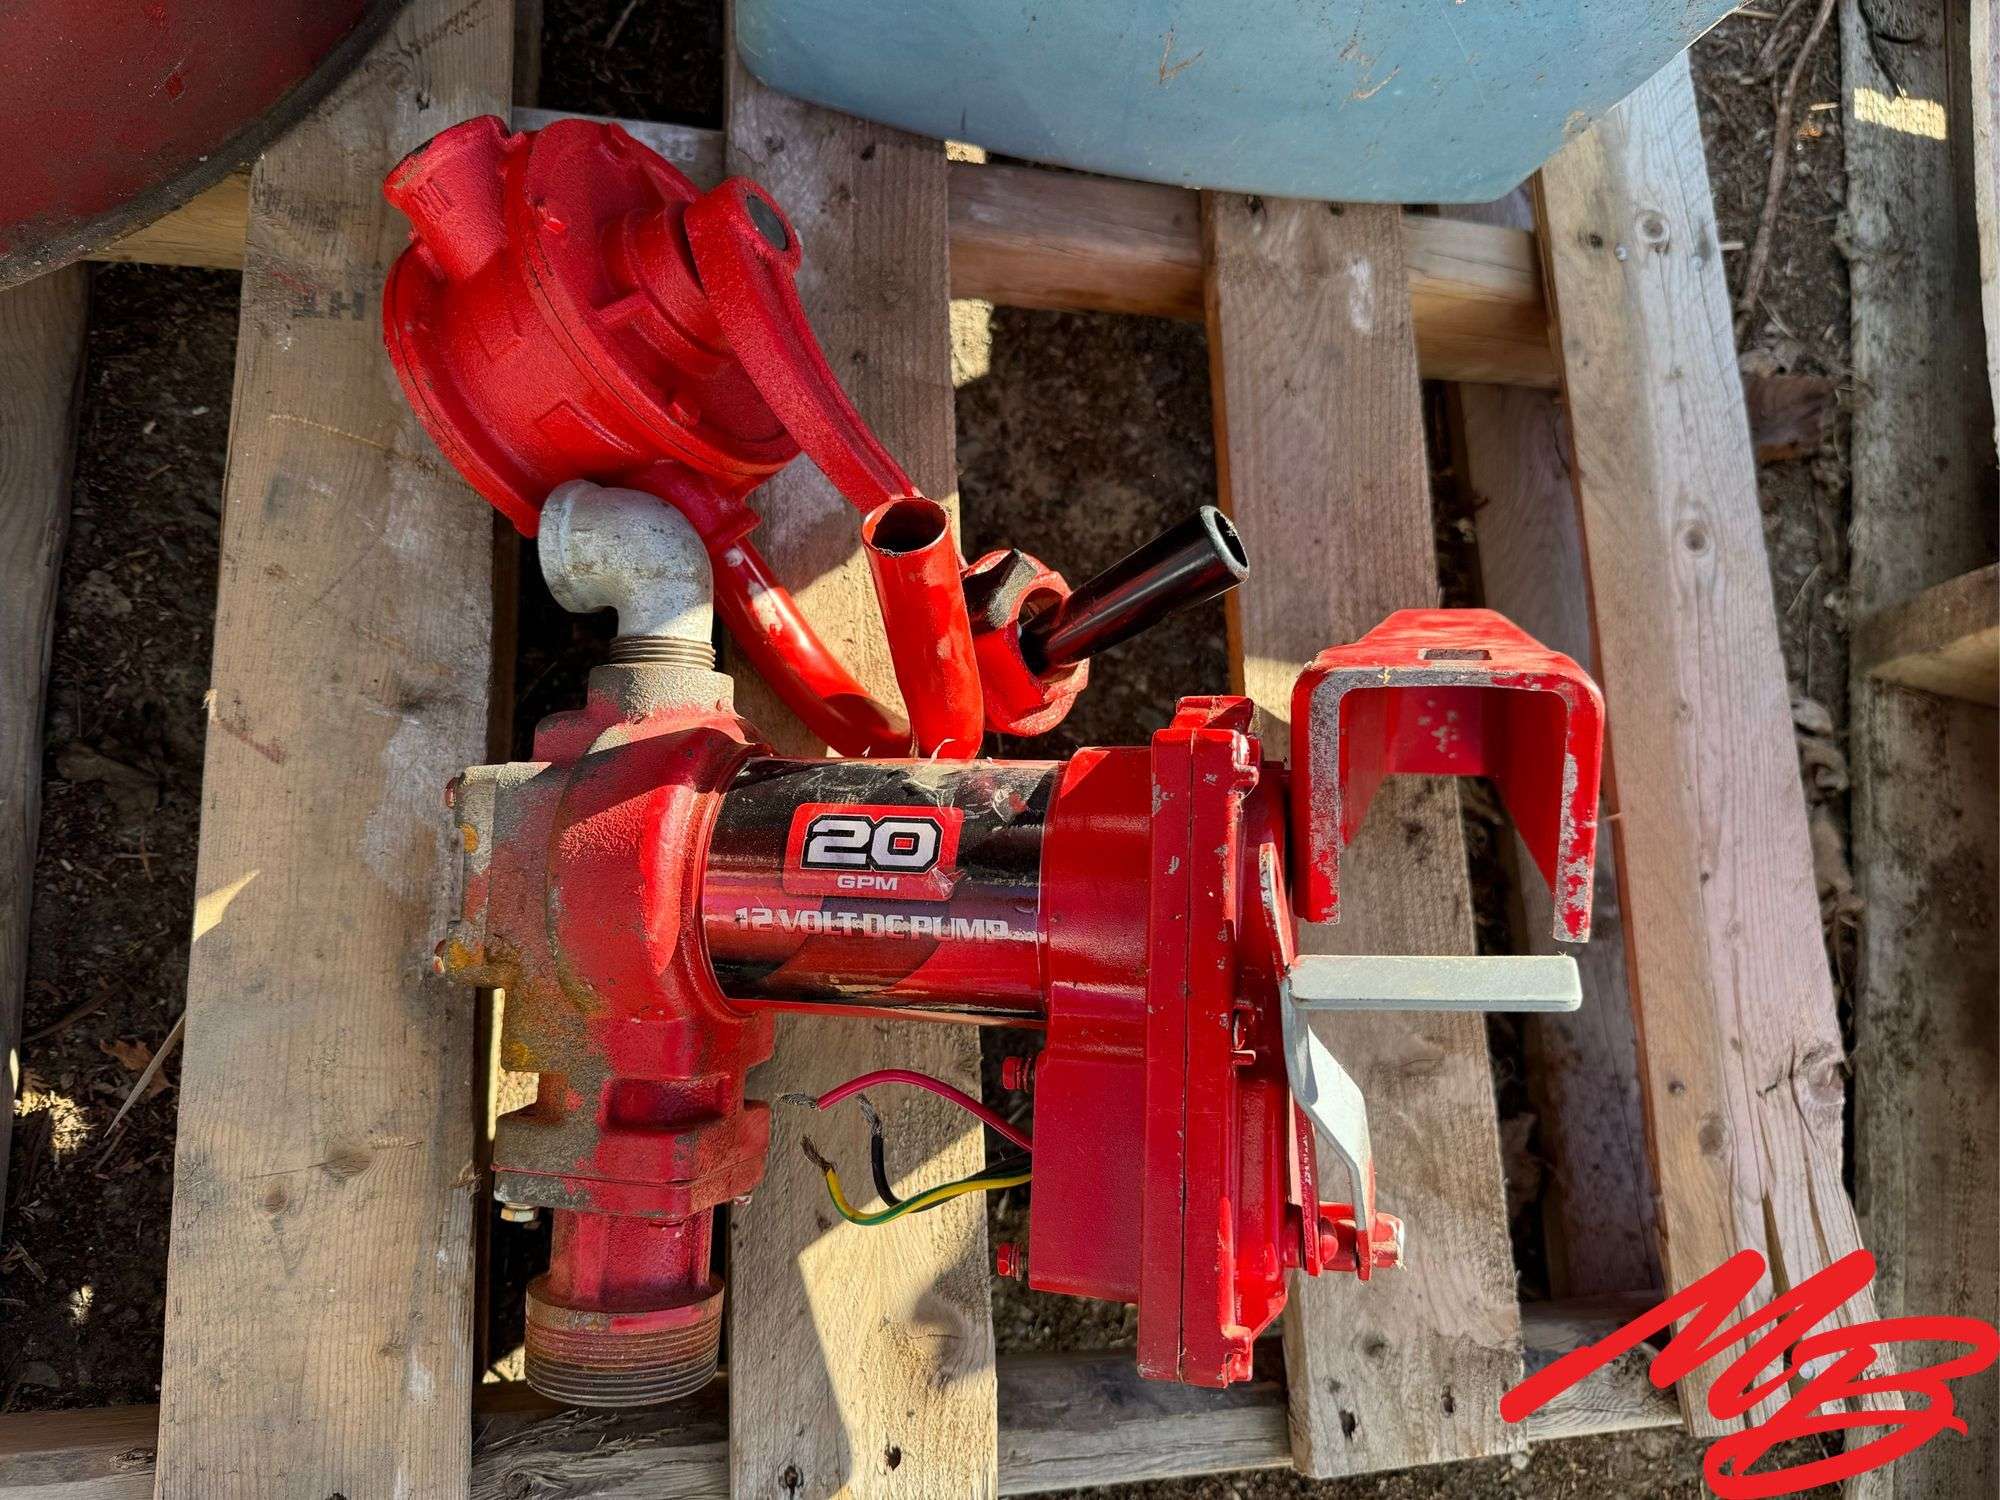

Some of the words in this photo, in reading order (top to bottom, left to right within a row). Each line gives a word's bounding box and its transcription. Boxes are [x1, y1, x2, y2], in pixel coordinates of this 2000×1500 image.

[801, 814, 943, 874] 20
[837, 874, 898, 891] GPM
[735, 907, 773, 931] 12
[778, 909, 858, 937] VOLT
[862, 913, 906, 939] DC
[910, 915, 1010, 943] PUMP
